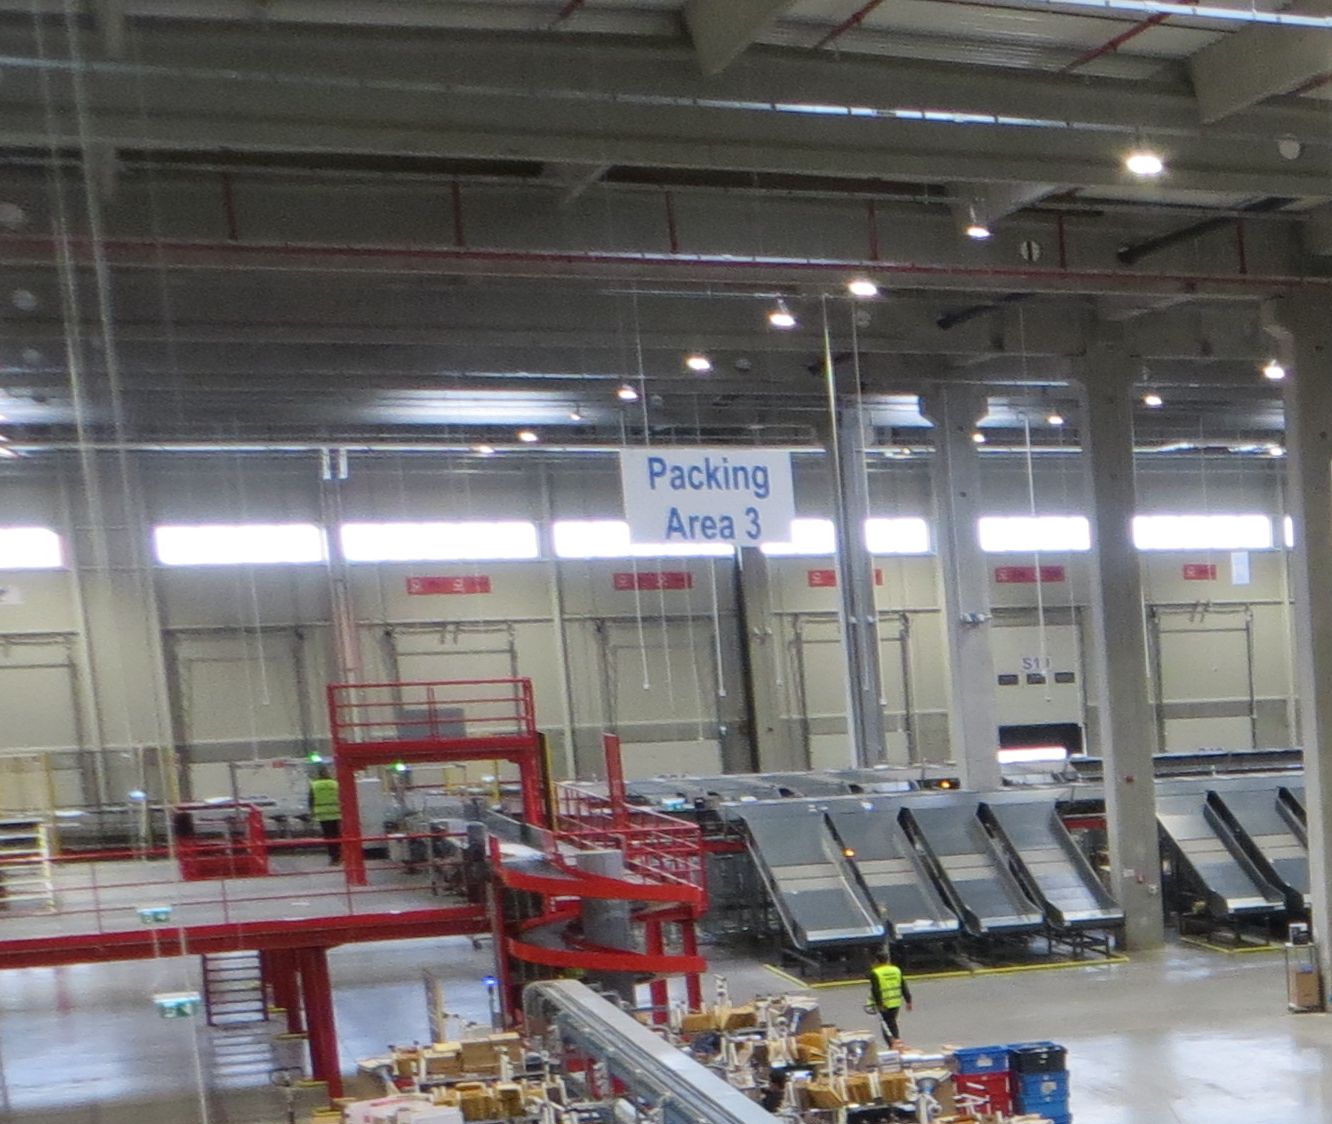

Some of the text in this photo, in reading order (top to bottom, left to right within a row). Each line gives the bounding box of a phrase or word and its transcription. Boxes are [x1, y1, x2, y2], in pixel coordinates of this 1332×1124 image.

[647, 456, 770, 498] Packing
[665, 506, 761, 540] Area 3
